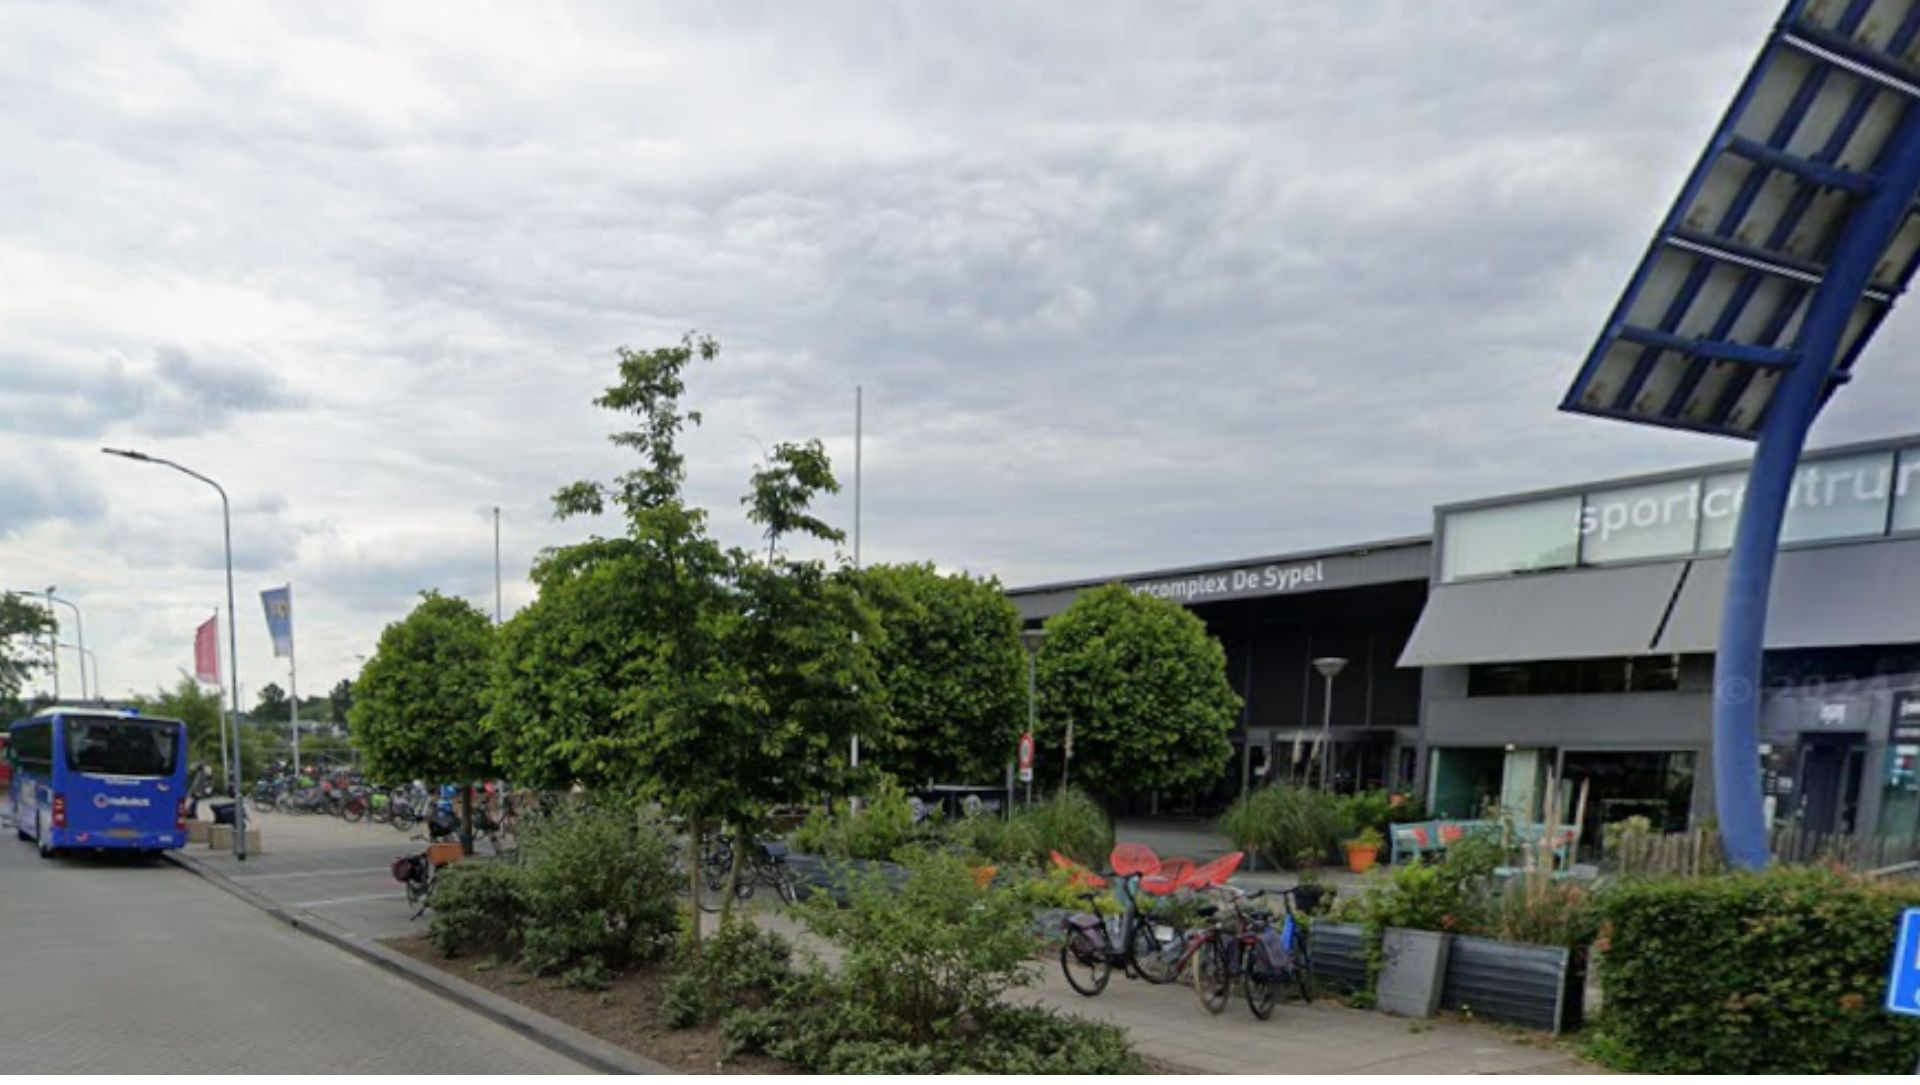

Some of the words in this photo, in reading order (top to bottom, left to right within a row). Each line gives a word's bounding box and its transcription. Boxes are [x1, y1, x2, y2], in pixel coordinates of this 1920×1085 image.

[1574, 459, 1920, 542] sportctru
[1232, 568, 1260, 591] De
[1263, 560, 1324, 591] Sypel
